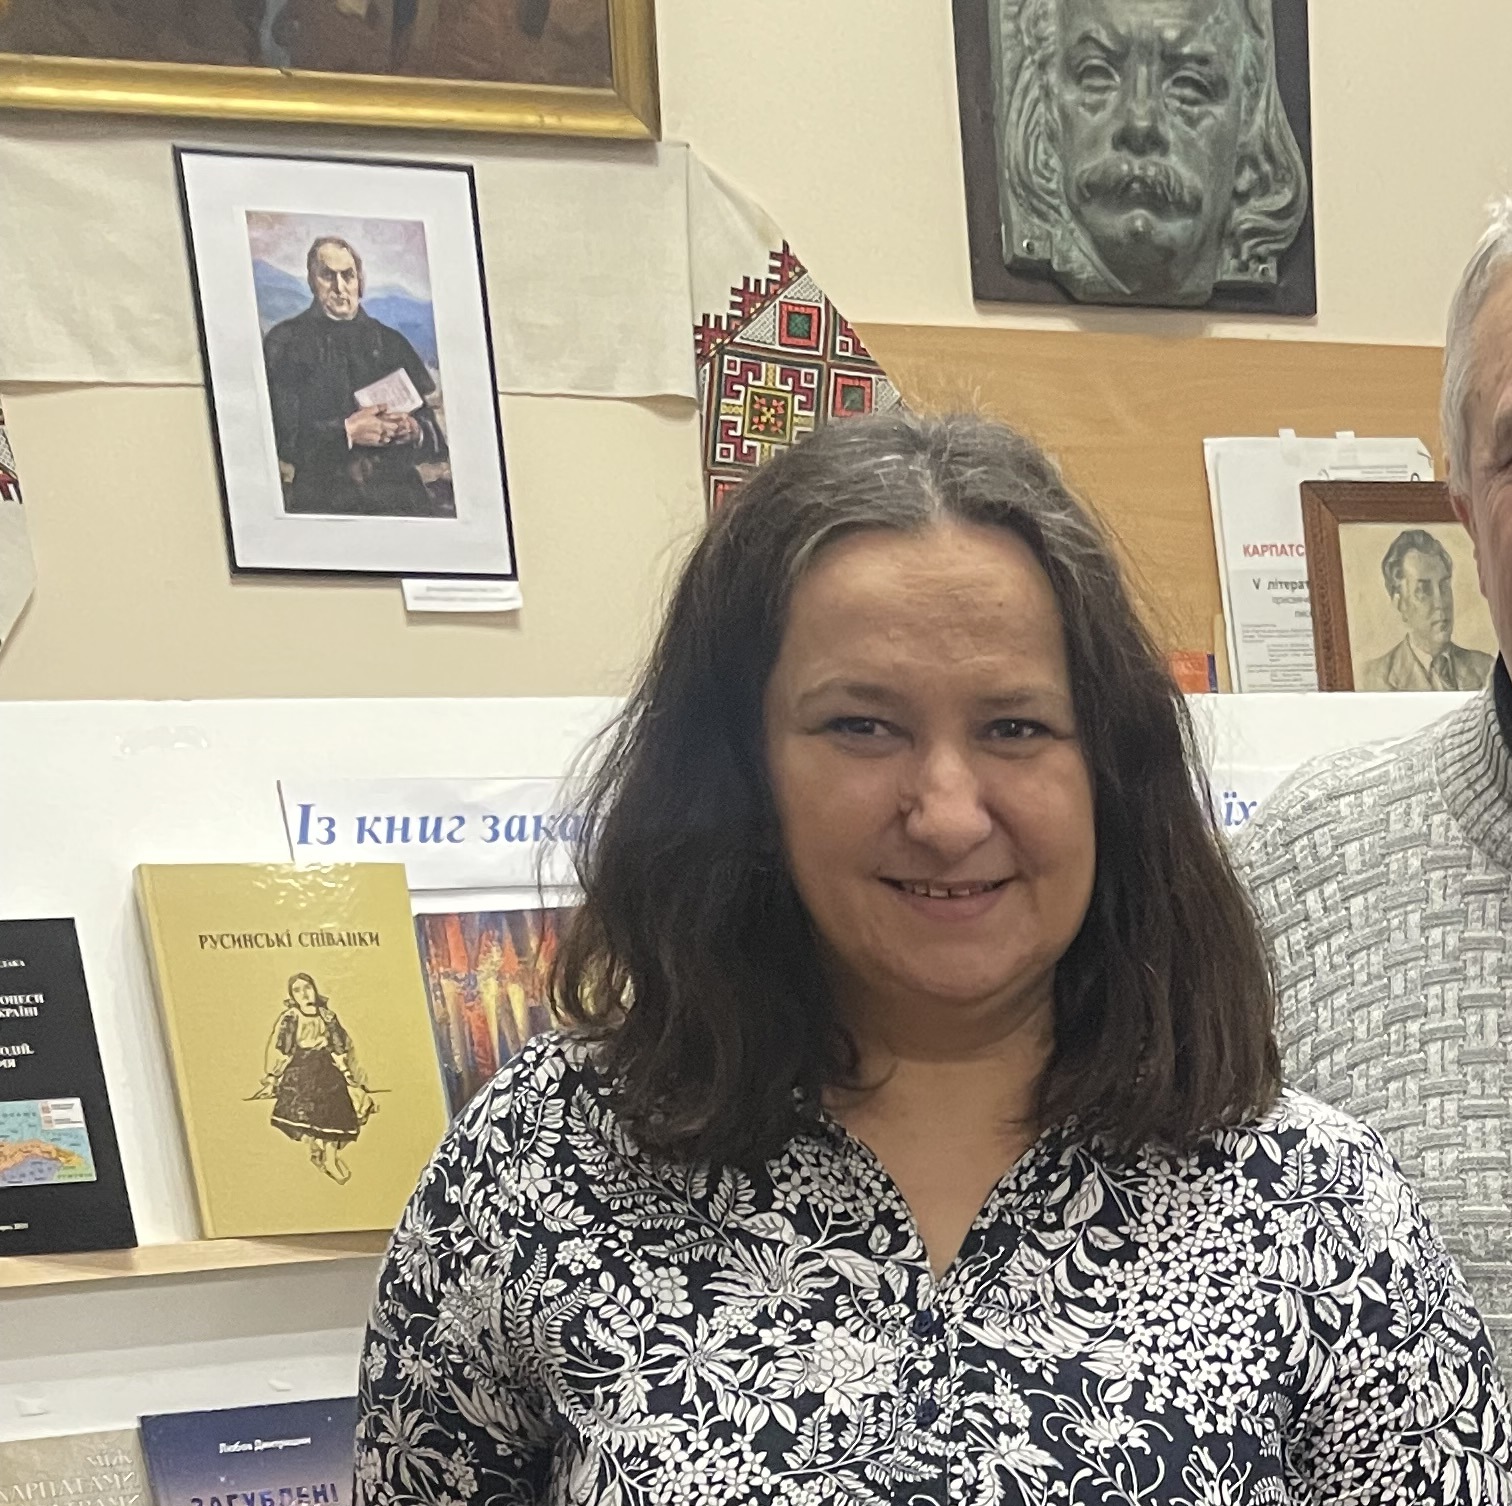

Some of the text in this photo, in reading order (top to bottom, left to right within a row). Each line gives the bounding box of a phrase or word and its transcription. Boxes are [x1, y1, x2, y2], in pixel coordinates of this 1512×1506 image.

[296, 802, 336, 846] Із
[355, 815, 465, 845] книг
[198, 929, 293, 950] РУСИНСЬКІ
